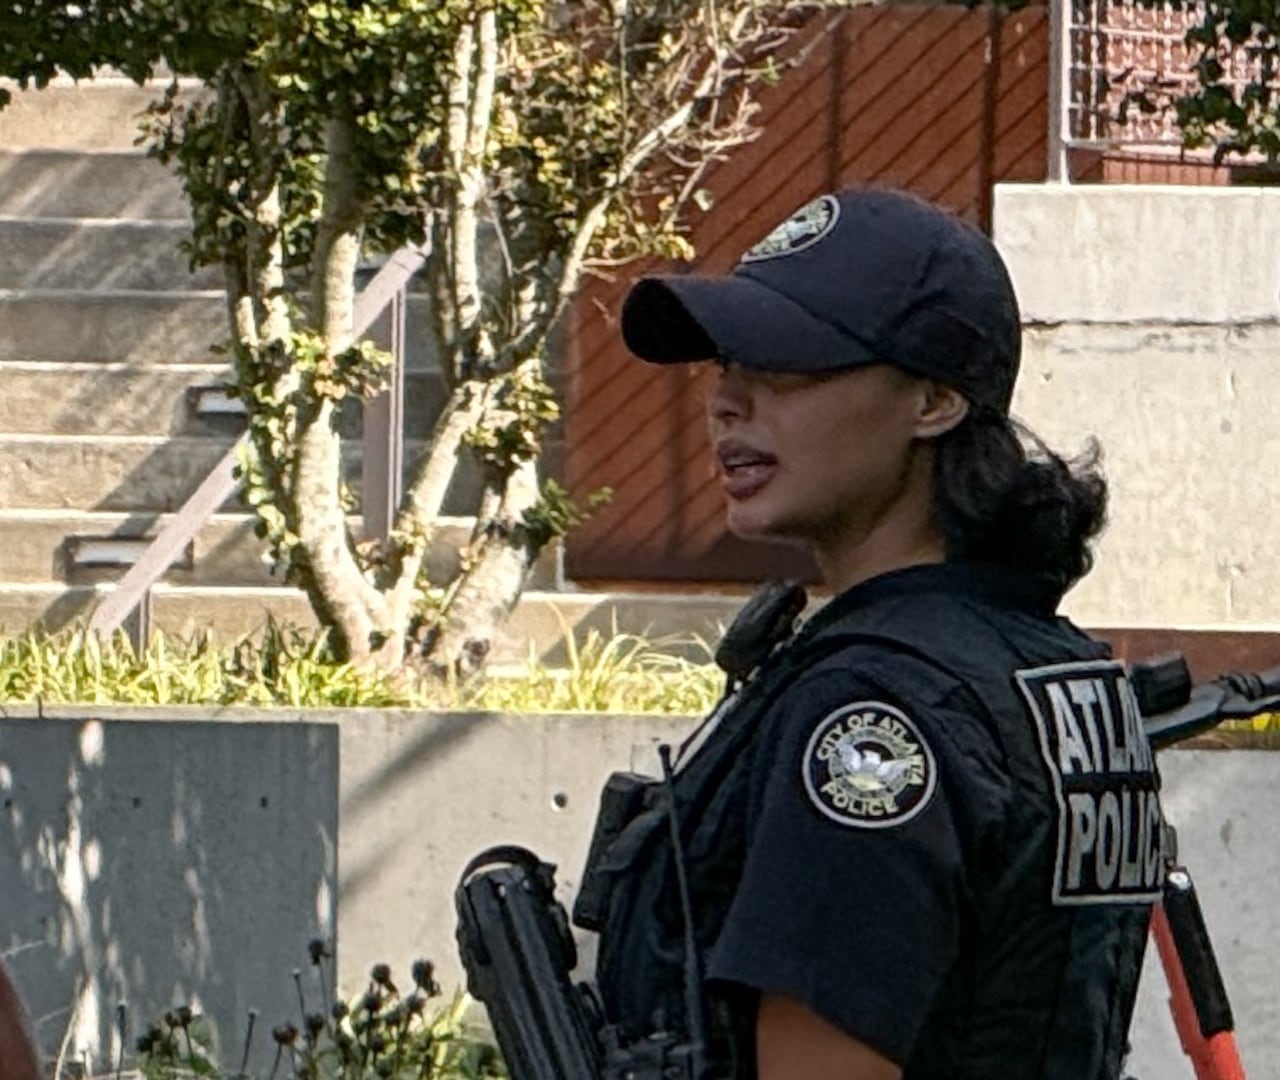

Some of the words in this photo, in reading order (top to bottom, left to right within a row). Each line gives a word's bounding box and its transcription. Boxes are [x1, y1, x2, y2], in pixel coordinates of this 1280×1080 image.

[816, 722, 845, 761] CITY
[846, 712, 877, 729] OF
[1045, 676, 1154, 774] ATLA
[820, 781, 900, 817] POLICE
